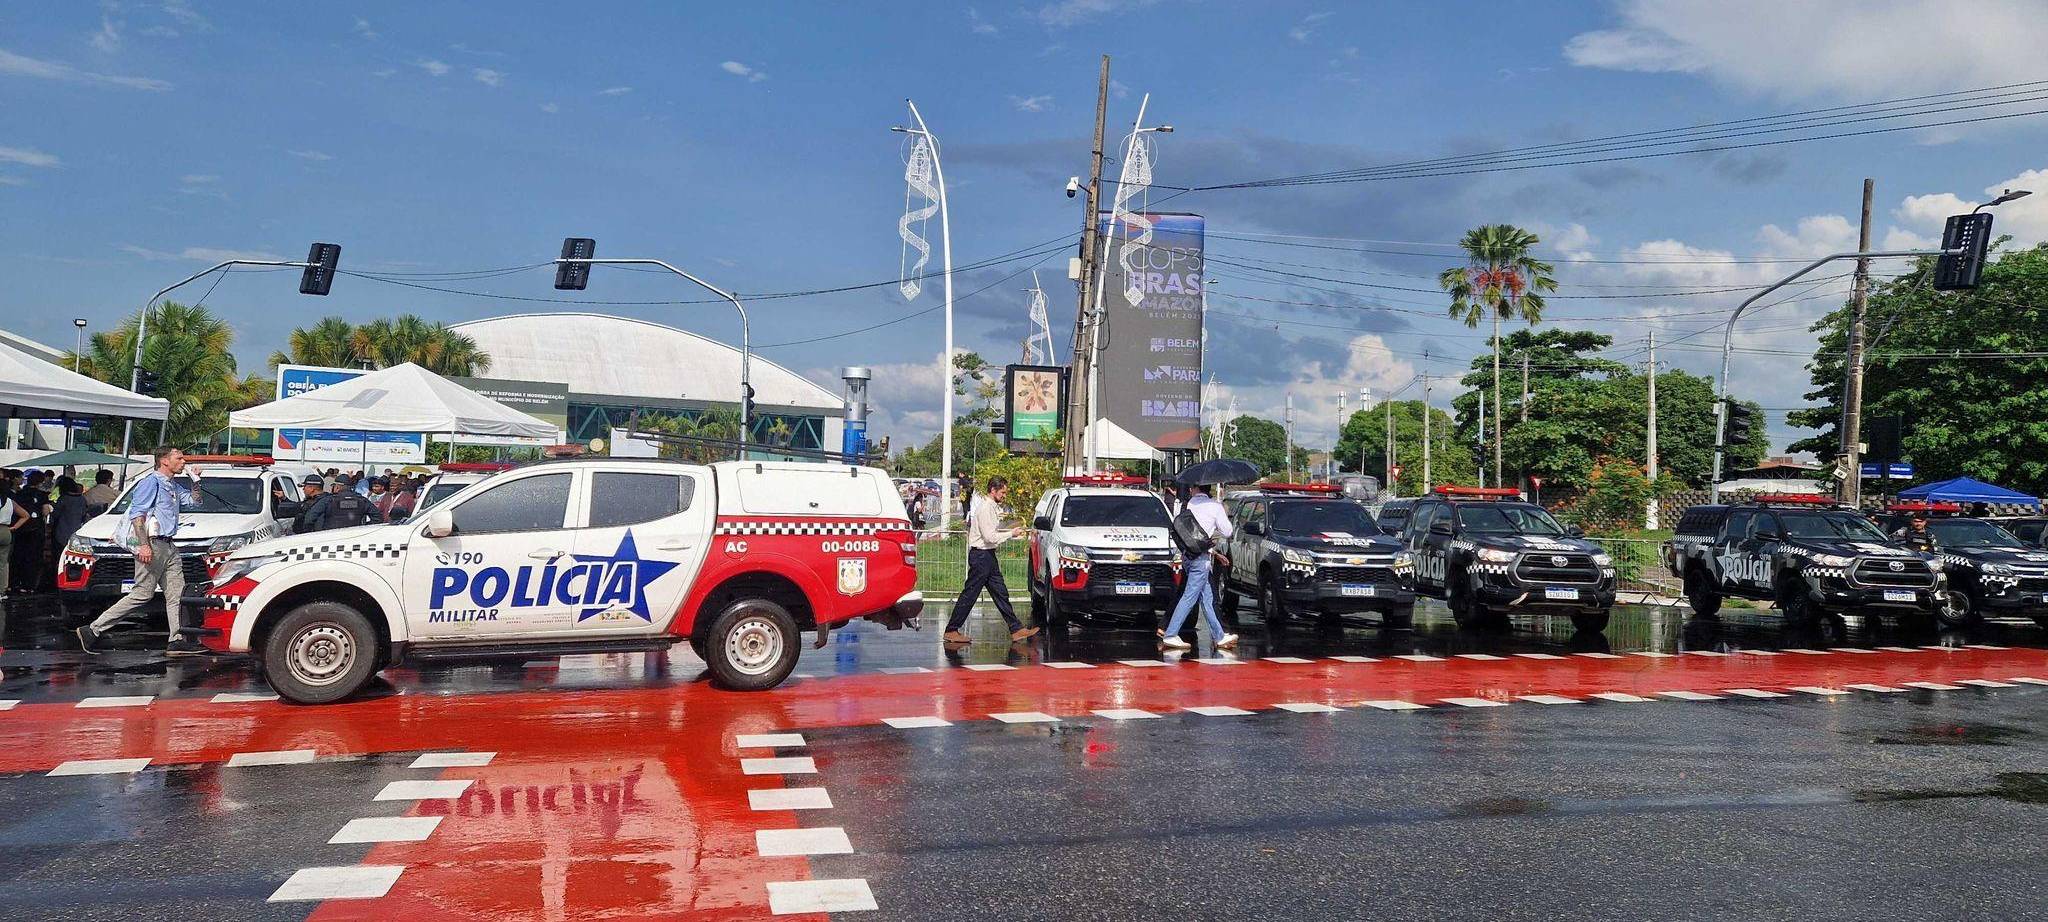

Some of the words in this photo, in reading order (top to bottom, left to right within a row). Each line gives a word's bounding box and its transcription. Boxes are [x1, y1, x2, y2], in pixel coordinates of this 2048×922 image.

[288, 381, 315, 390] OBRA
[1141, 400, 1200, 417] BRASIL
[725, 541, 748, 553] AC
[822, 541, 880, 553] 00-0088
[453, 552, 483, 565] 190
[429, 556, 633, 610] POLÍCIA
[429, 609, 499, 623] MILITAR
